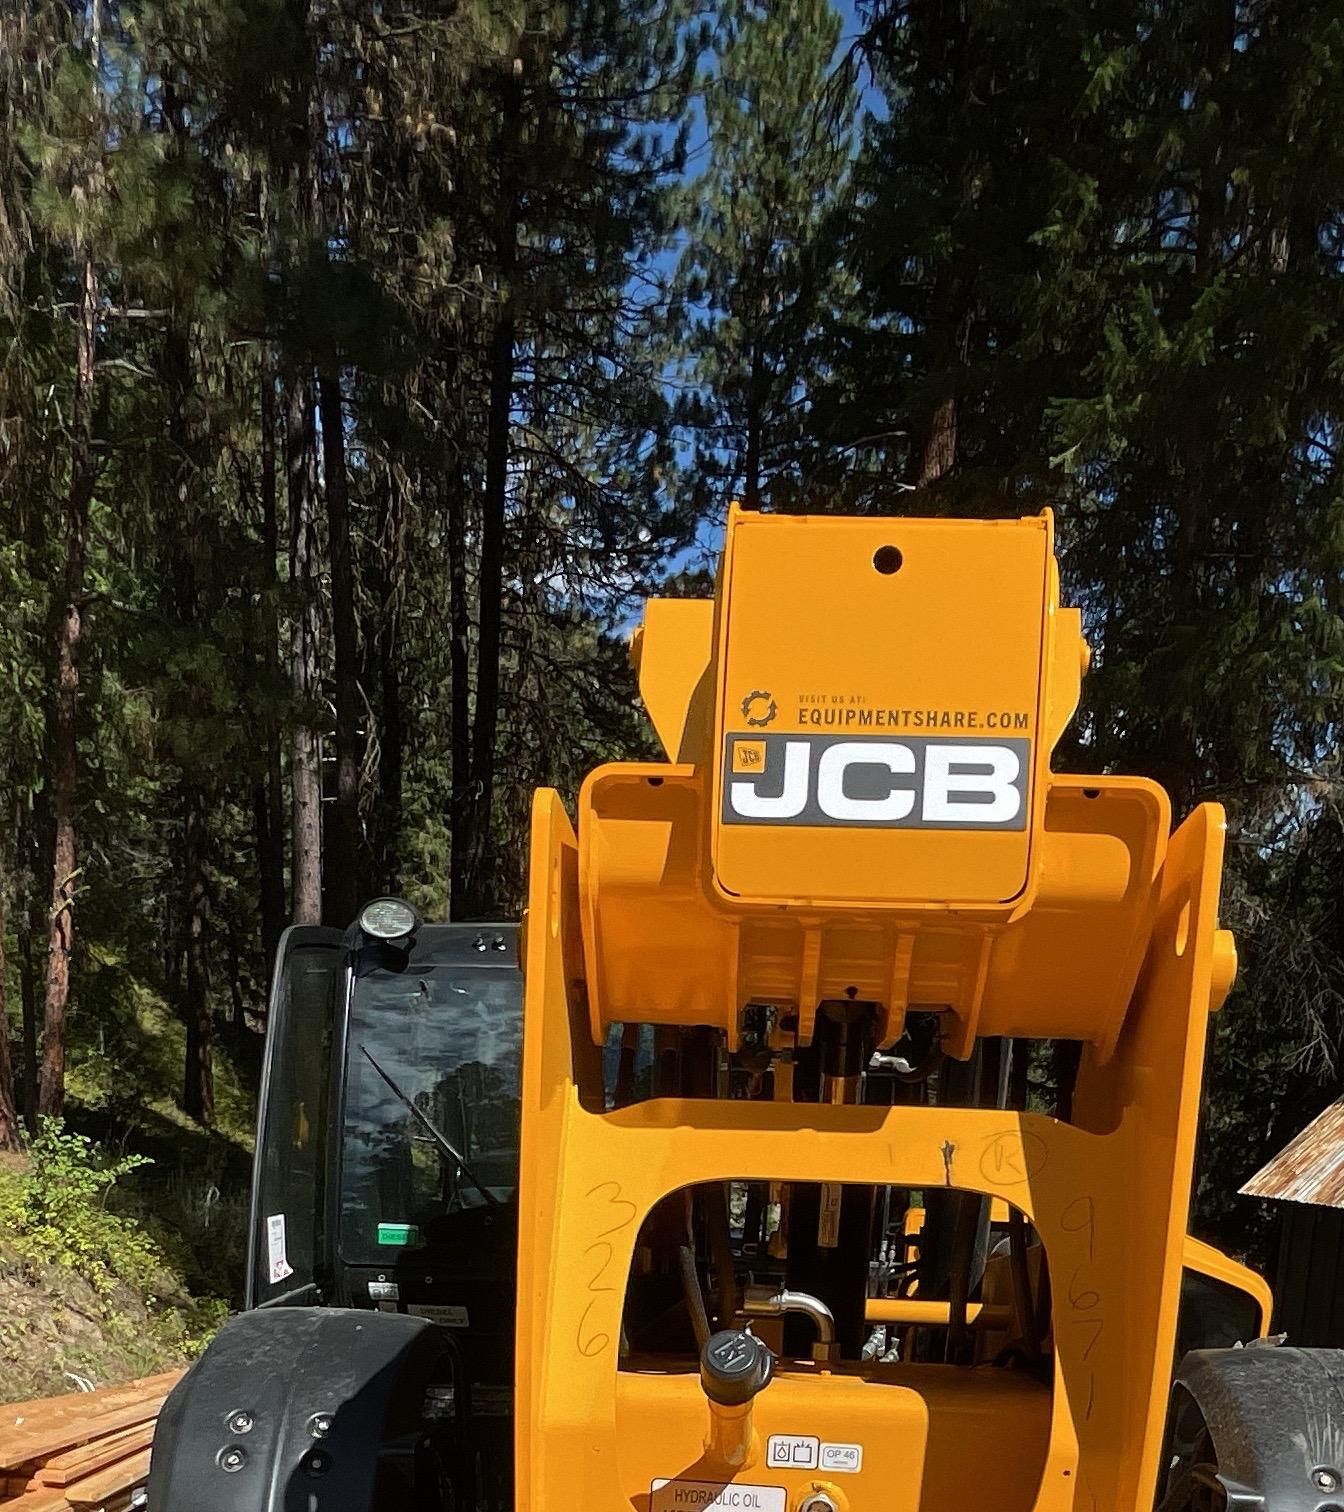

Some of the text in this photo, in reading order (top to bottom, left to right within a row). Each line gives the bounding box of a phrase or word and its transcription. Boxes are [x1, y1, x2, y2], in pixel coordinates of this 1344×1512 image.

[798, 695, 827, 704] VISIT
[831, 695, 845, 704] US
[798, 708, 1030, 730] EQUIPMENTSHARE.COM
[730, 740, 1022, 824] JCB
[826, 1449, 856, 1460] OP 46
[674, 1488, 761, 1509] HYDRAULIC OIL
